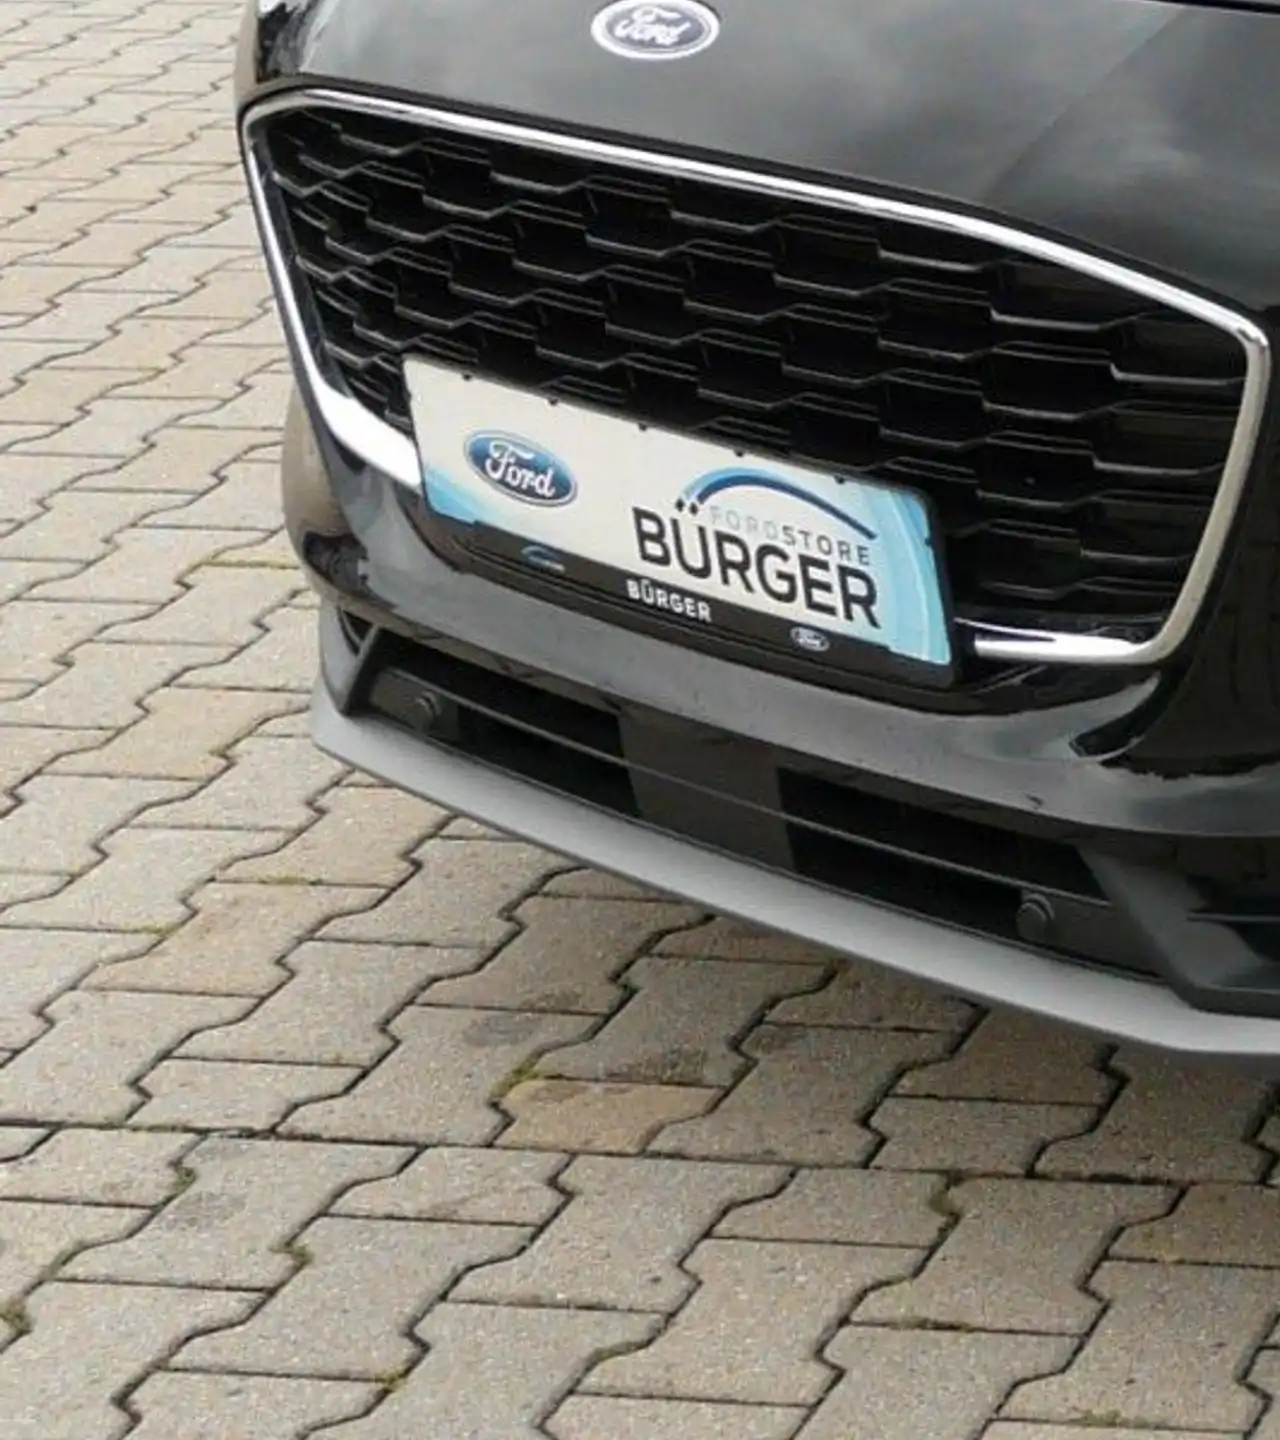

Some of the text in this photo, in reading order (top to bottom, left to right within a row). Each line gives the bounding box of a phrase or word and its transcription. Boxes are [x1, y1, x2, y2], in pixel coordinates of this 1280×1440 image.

[485, 440, 557, 497] Ford
[632, 498, 882, 630] BÜRGER
[710, 505, 871, 566] FORDSTORE
[626, 577, 713, 623] BÜRGER
